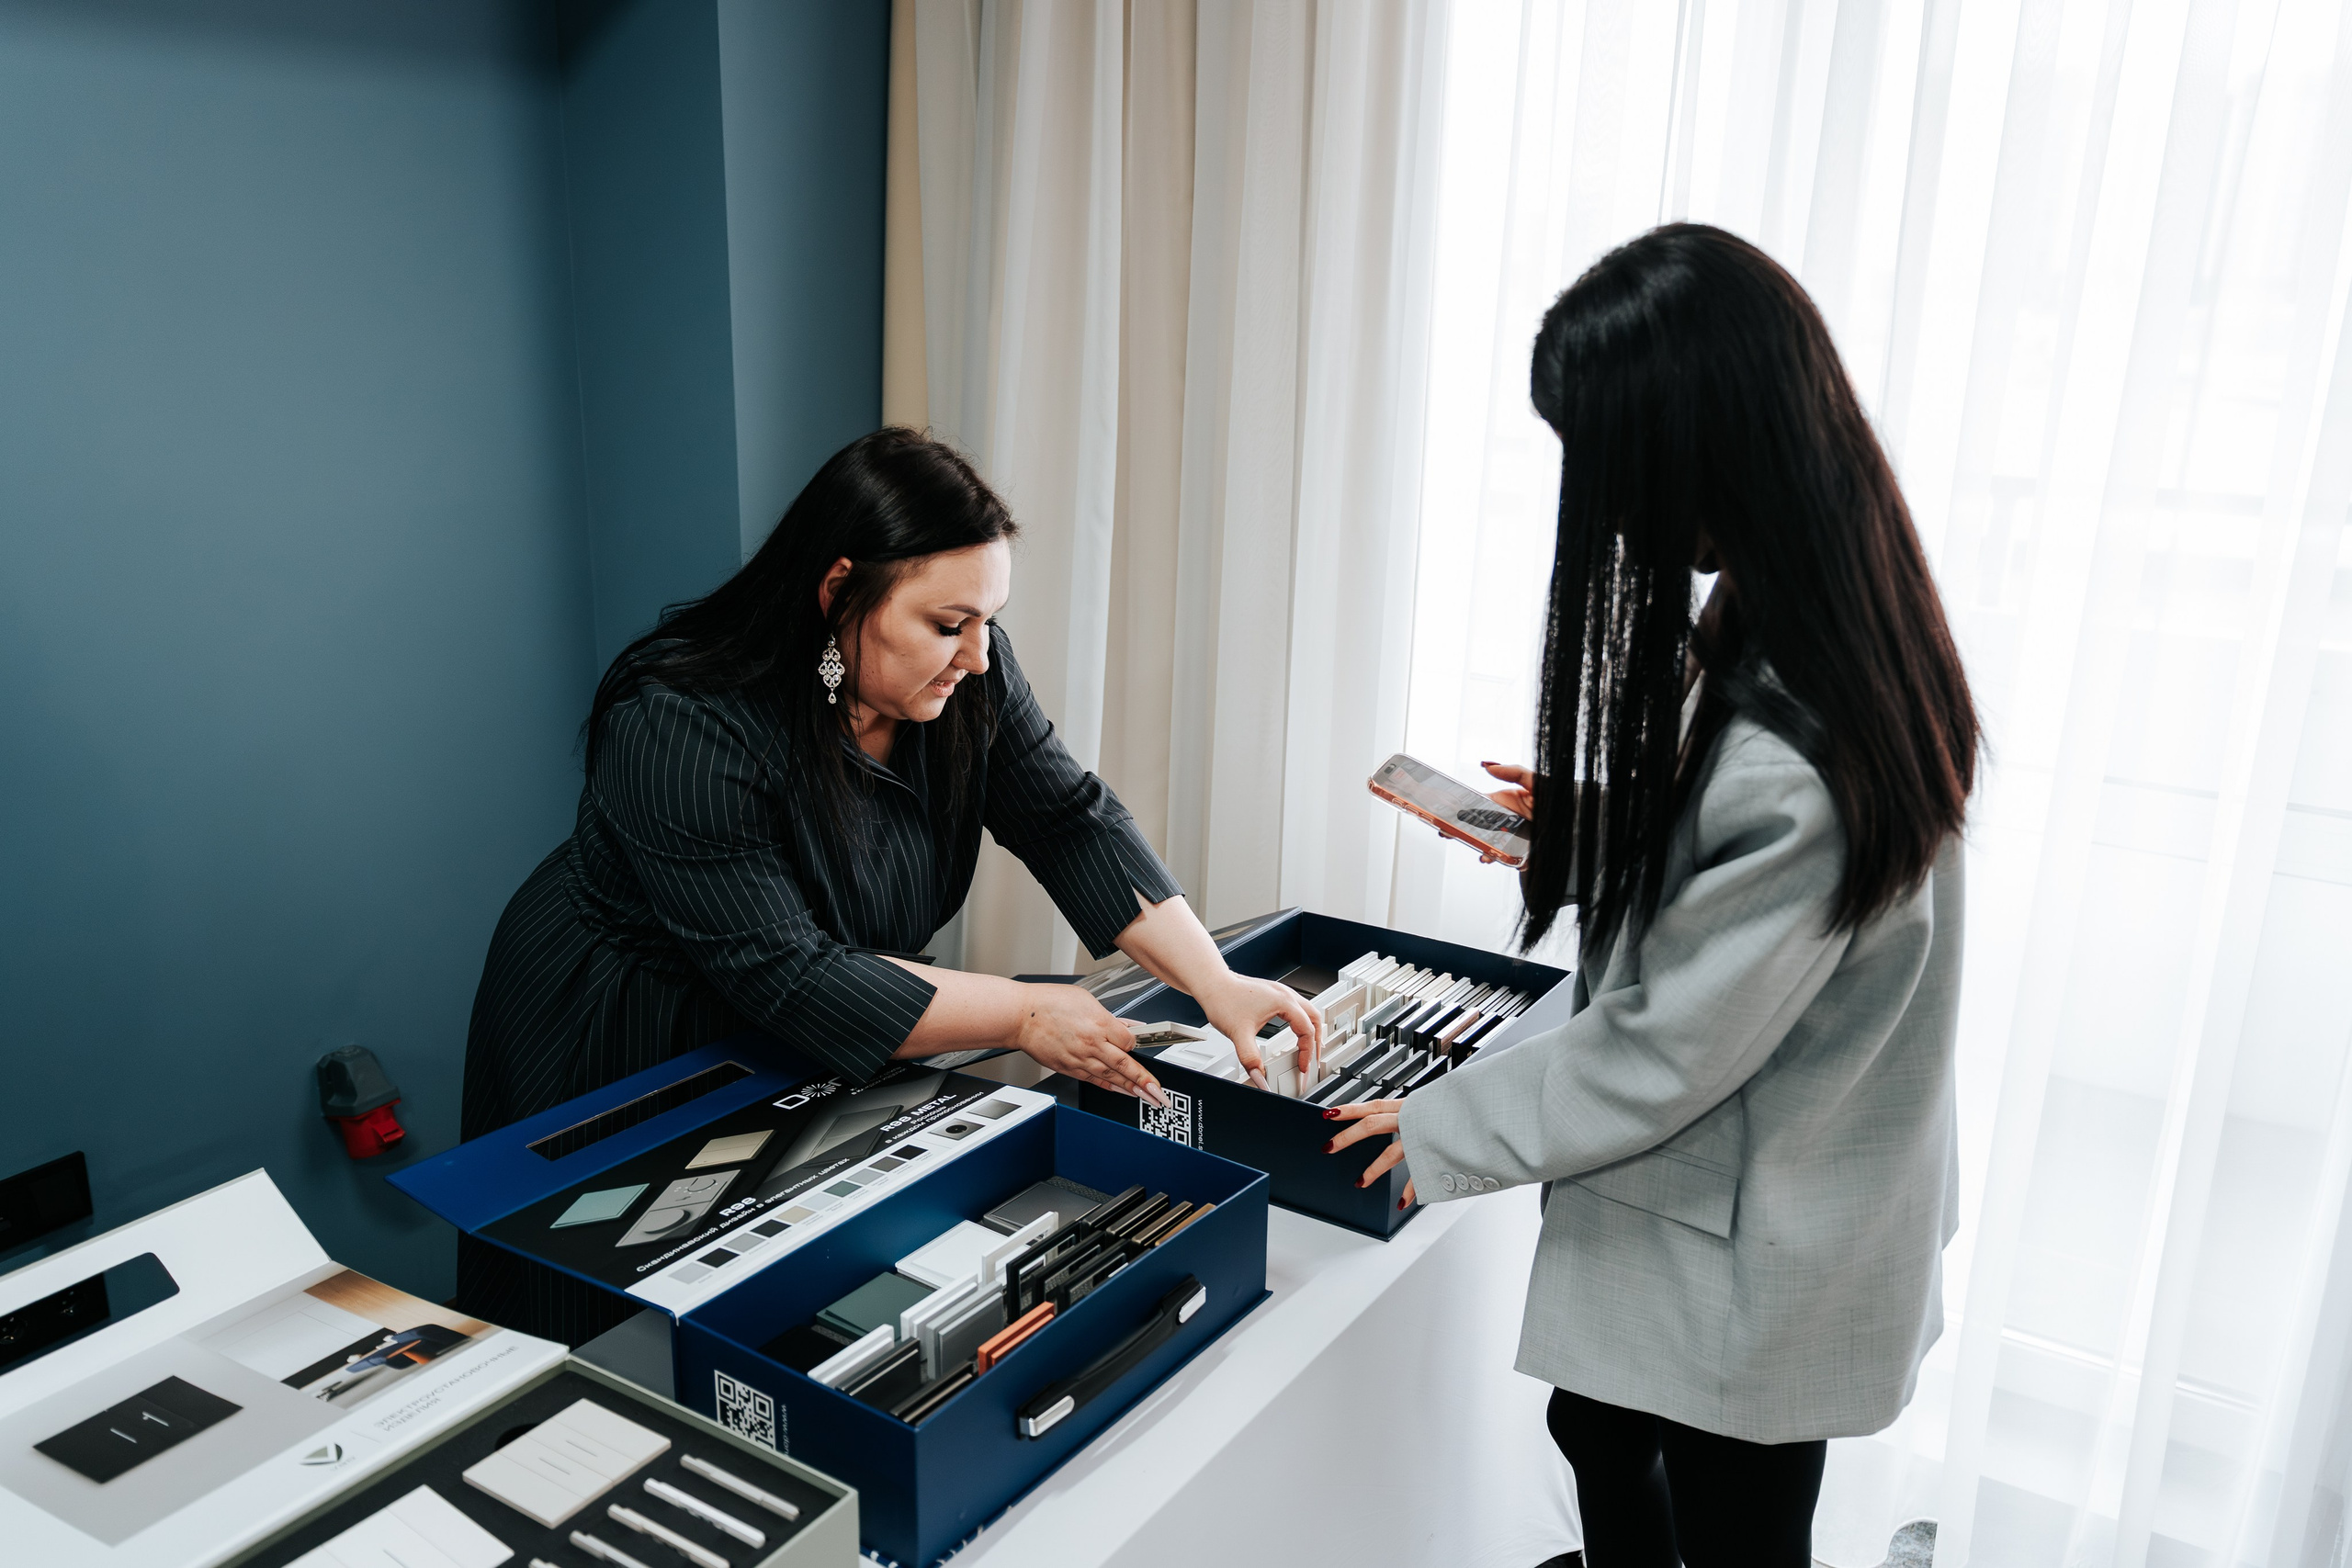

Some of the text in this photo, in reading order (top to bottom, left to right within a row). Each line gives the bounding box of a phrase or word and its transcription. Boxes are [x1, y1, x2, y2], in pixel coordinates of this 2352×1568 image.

[879, 1093, 957, 1133] R98 METAL
[910, 1105, 947, 1125] Роскошь
[892, 1122, 926, 1140] каждом
[636, 1226, 719, 1272] Скандинавский
[718, 1207, 756, 1229] дизайн
[764, 1174, 819, 1204] элегантных
[818, 1157, 851, 1176] цветах
[718, 1197, 757, 1217] R98
[374, 1345, 519, 1428] ЭЛЕКТРОУСТАНОВОЧНЫЕ
[384, 1398, 442, 1432] ИЗДЕЛИЯ
